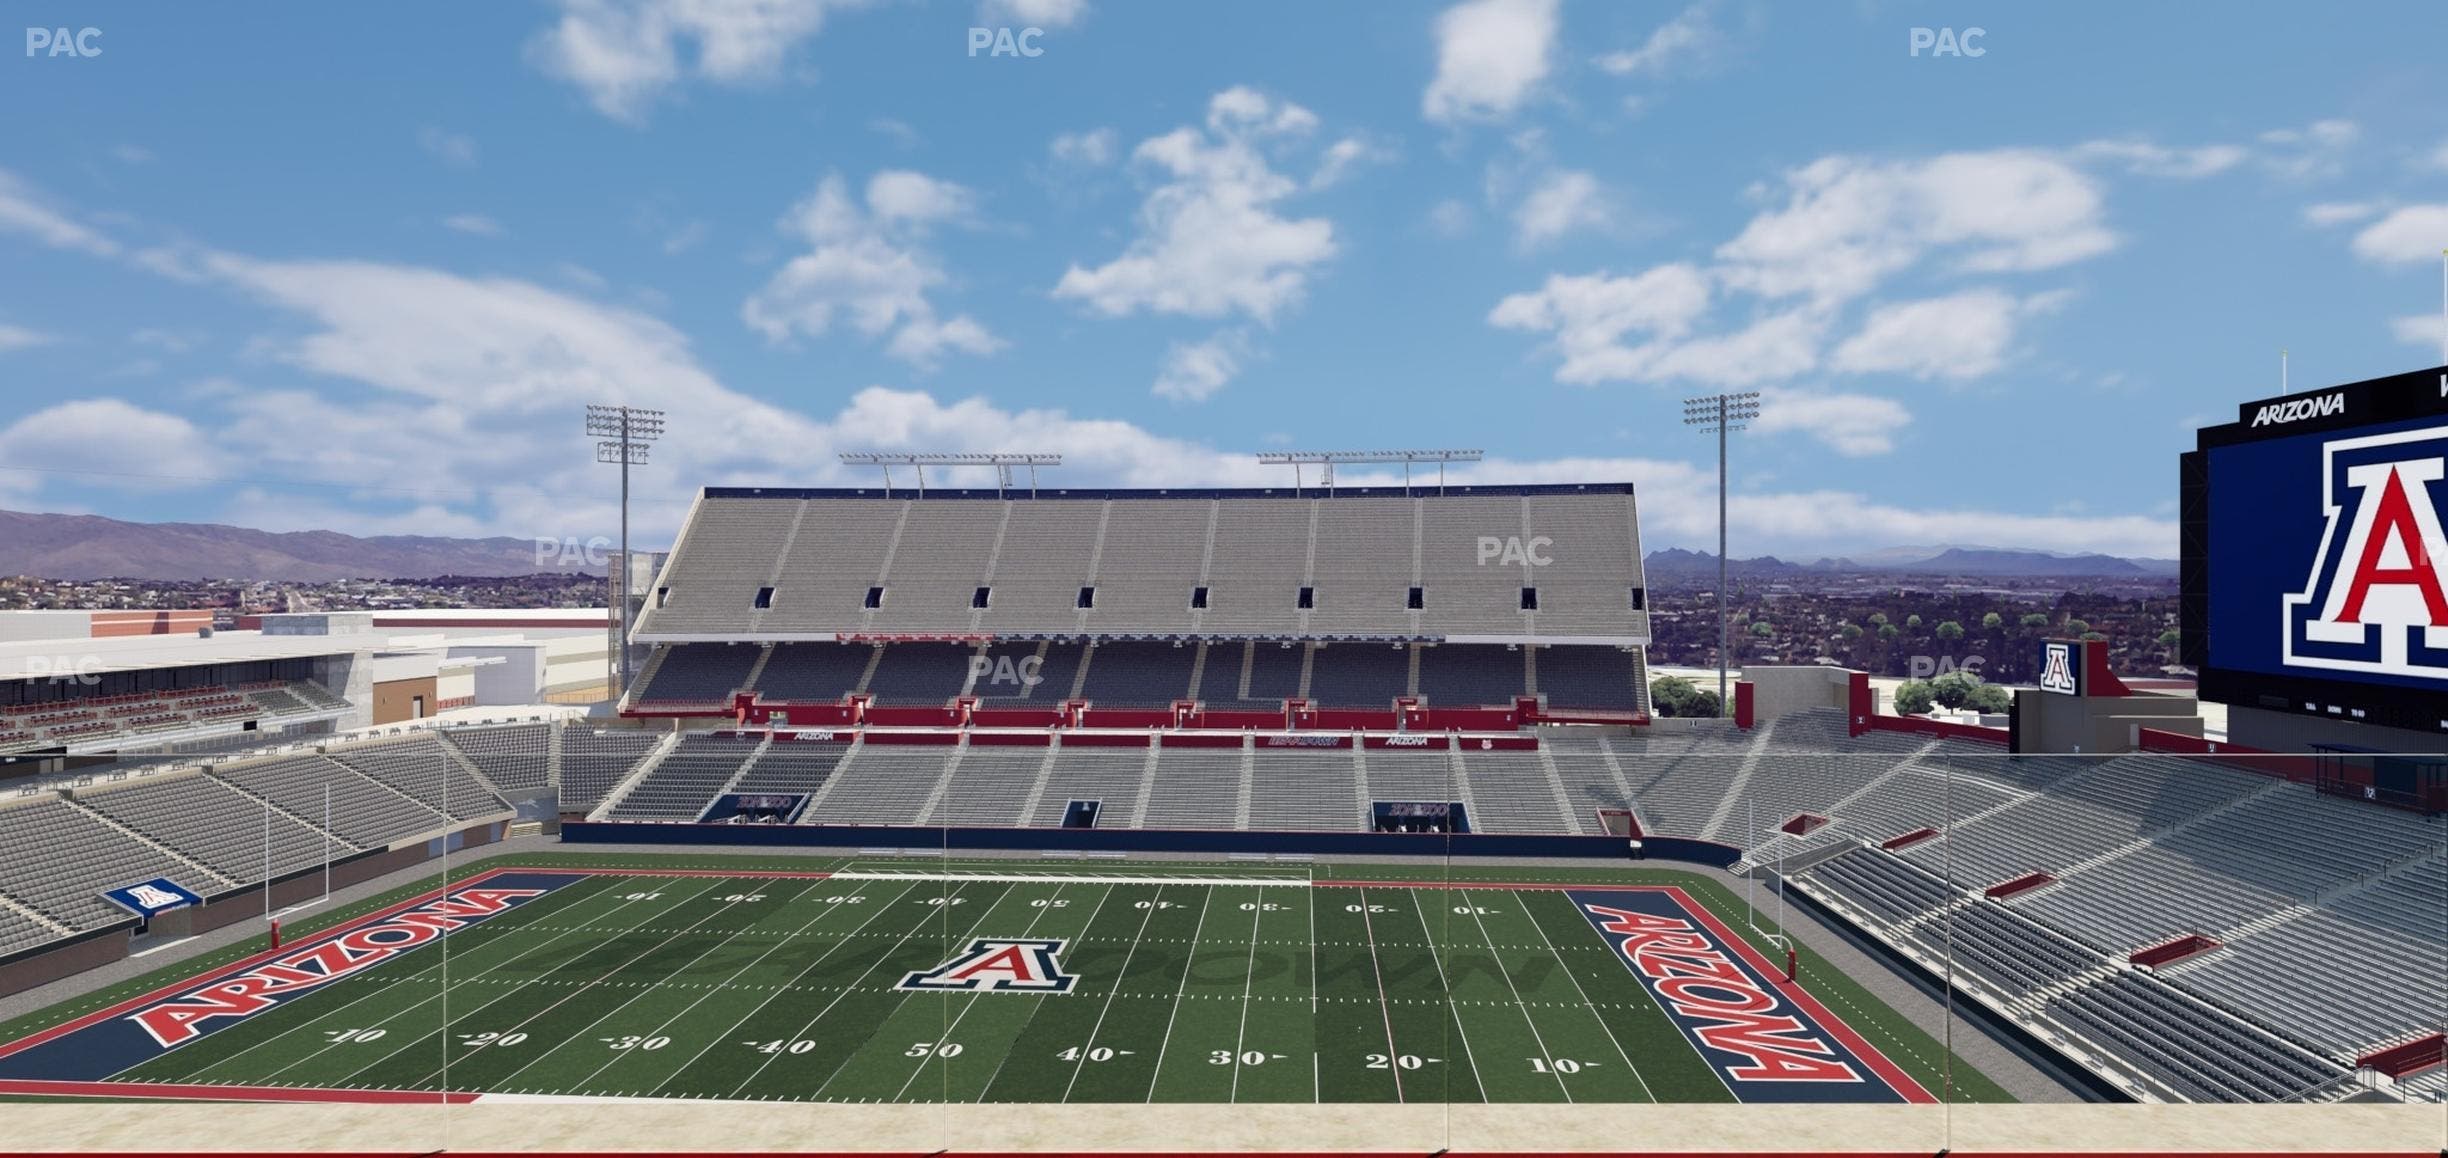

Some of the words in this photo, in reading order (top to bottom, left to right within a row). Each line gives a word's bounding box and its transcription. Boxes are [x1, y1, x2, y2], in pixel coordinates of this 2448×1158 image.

[2251, 393, 2345, 427] ARIZONA
[1386, 736, 1428, 746] ARIZONA
[125, 888, 548, 1047] ARIZONA
[1585, 904, 1866, 1084] ARIZONA
[324, 1028, 387, 1044] 10
[462, 1031, 529, 1047] 20
[609, 1035, 671, 1051] 30
[756, 1039, 816, 1054] 40
[905, 1043, 964, 1058] 50
[1055, 1046, 1114, 1062] 40
[1208, 1050, 1266, 1066] 30
[1365, 1053, 1423, 1070] 20
[1525, 1057, 1580, 1074] 10
